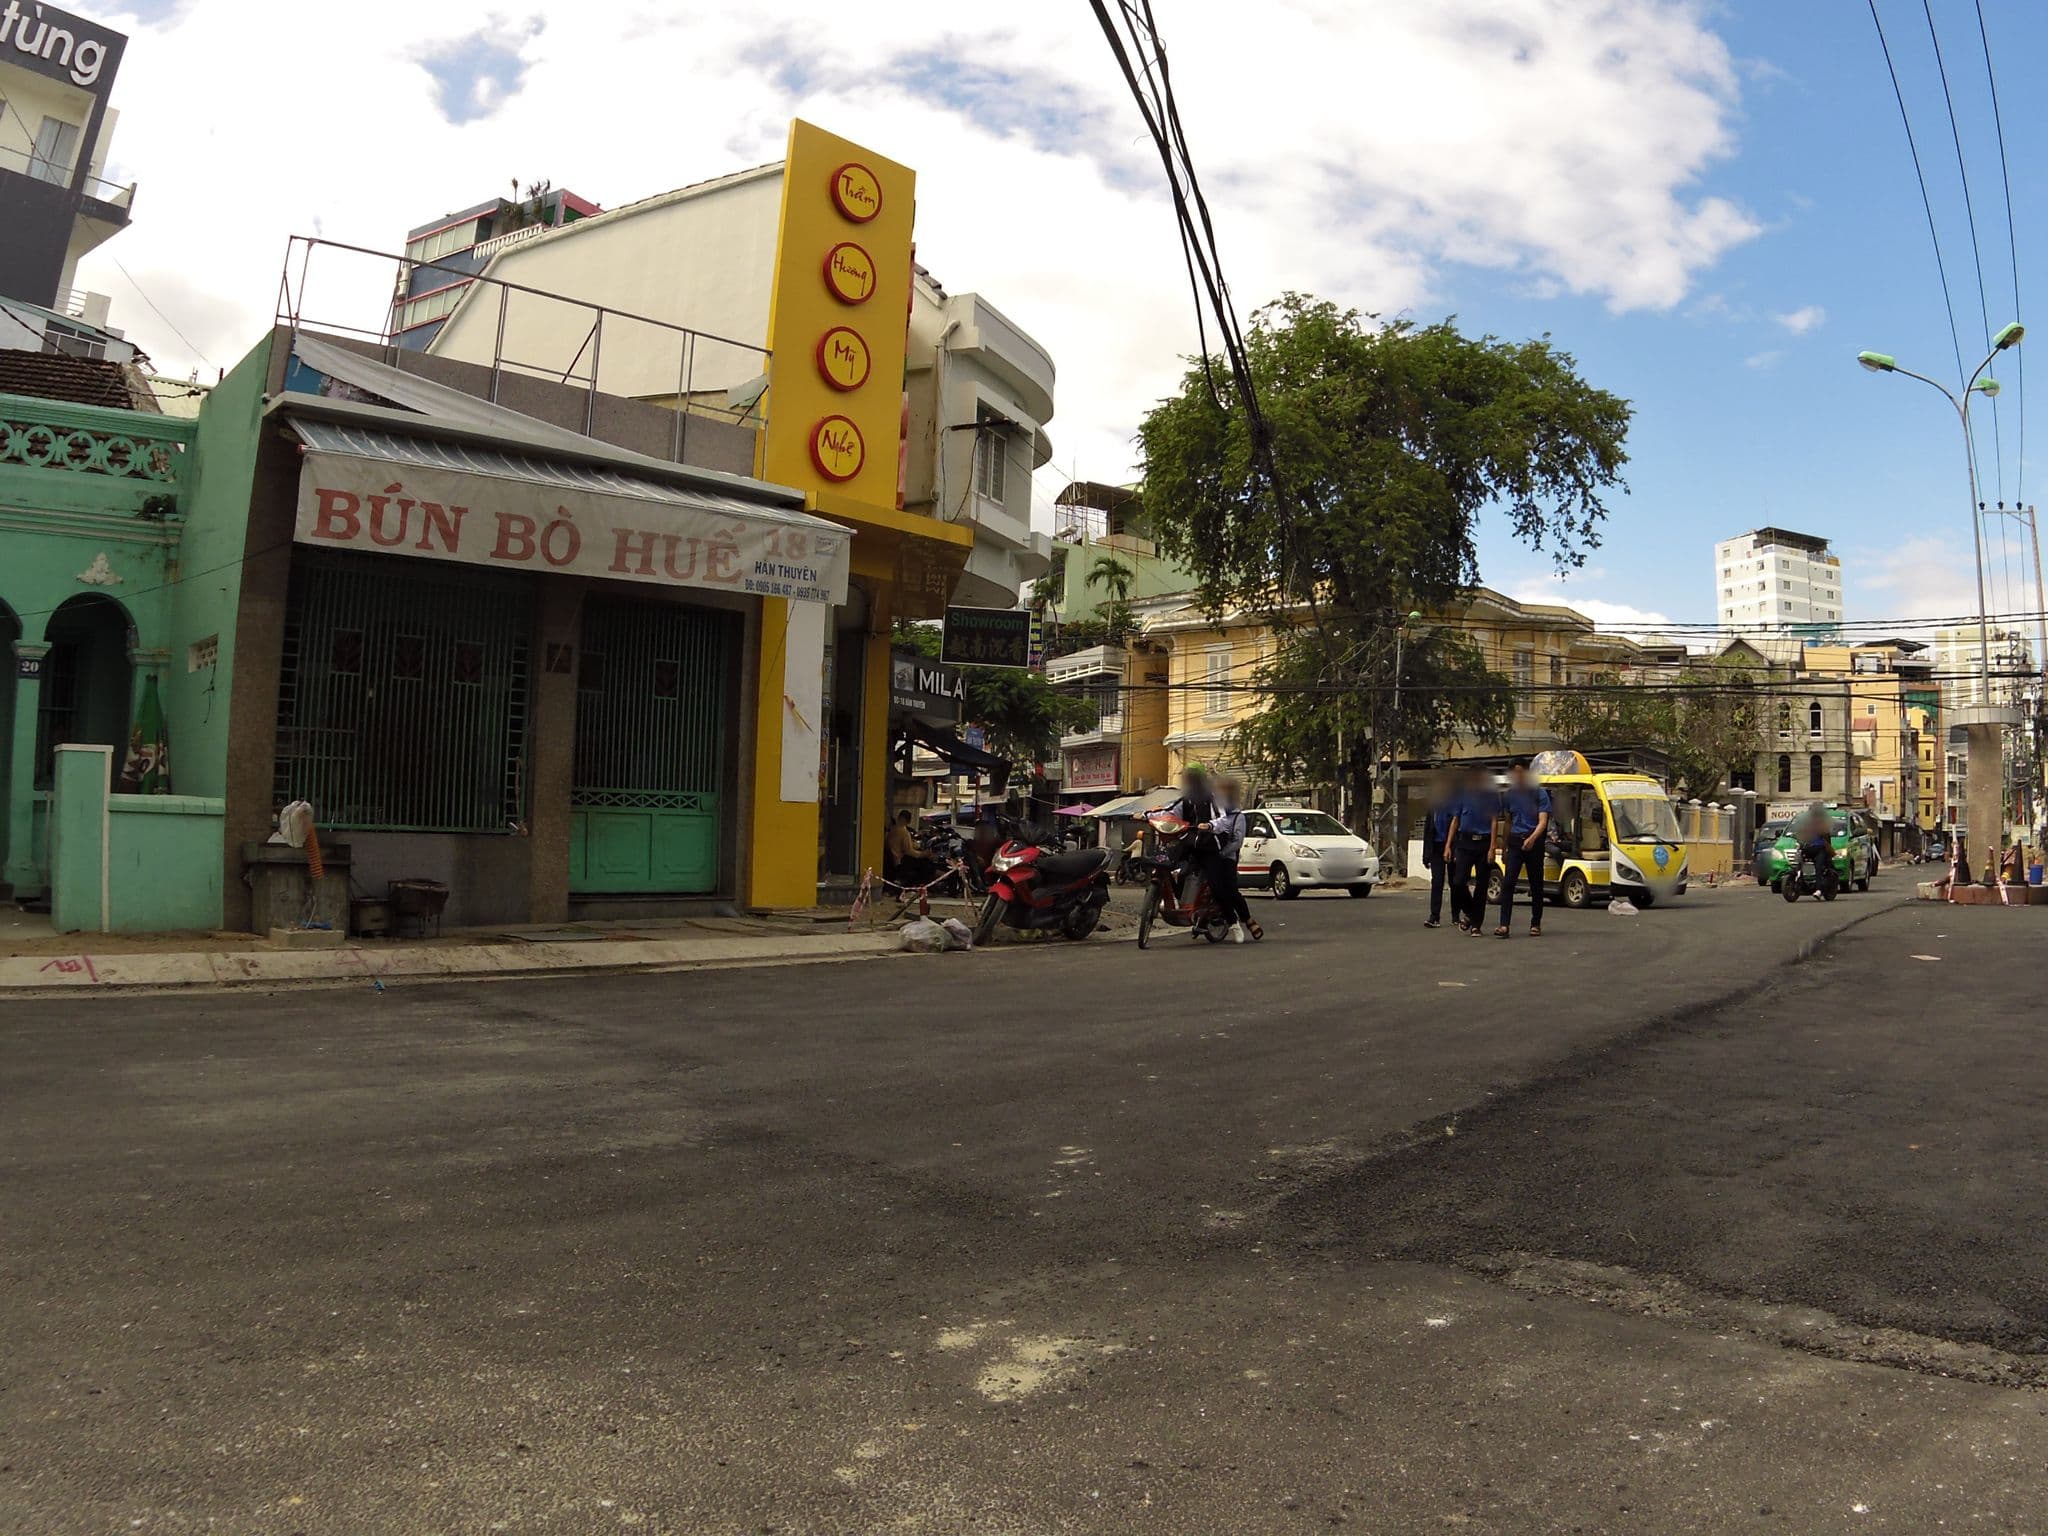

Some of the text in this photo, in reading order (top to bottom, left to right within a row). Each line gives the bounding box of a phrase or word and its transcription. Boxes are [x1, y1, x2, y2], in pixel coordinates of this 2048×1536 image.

[0, 0, 107, 86] tùng
[311, 482, 469, 553] BÚN
[490, 505, 581, 567] BÒ
[607, 523, 746, 584] HUẾ
[765, 527, 807, 561] 18
[951, 612, 1024, 631] Showroom
[21, 661, 39, 673] 20
